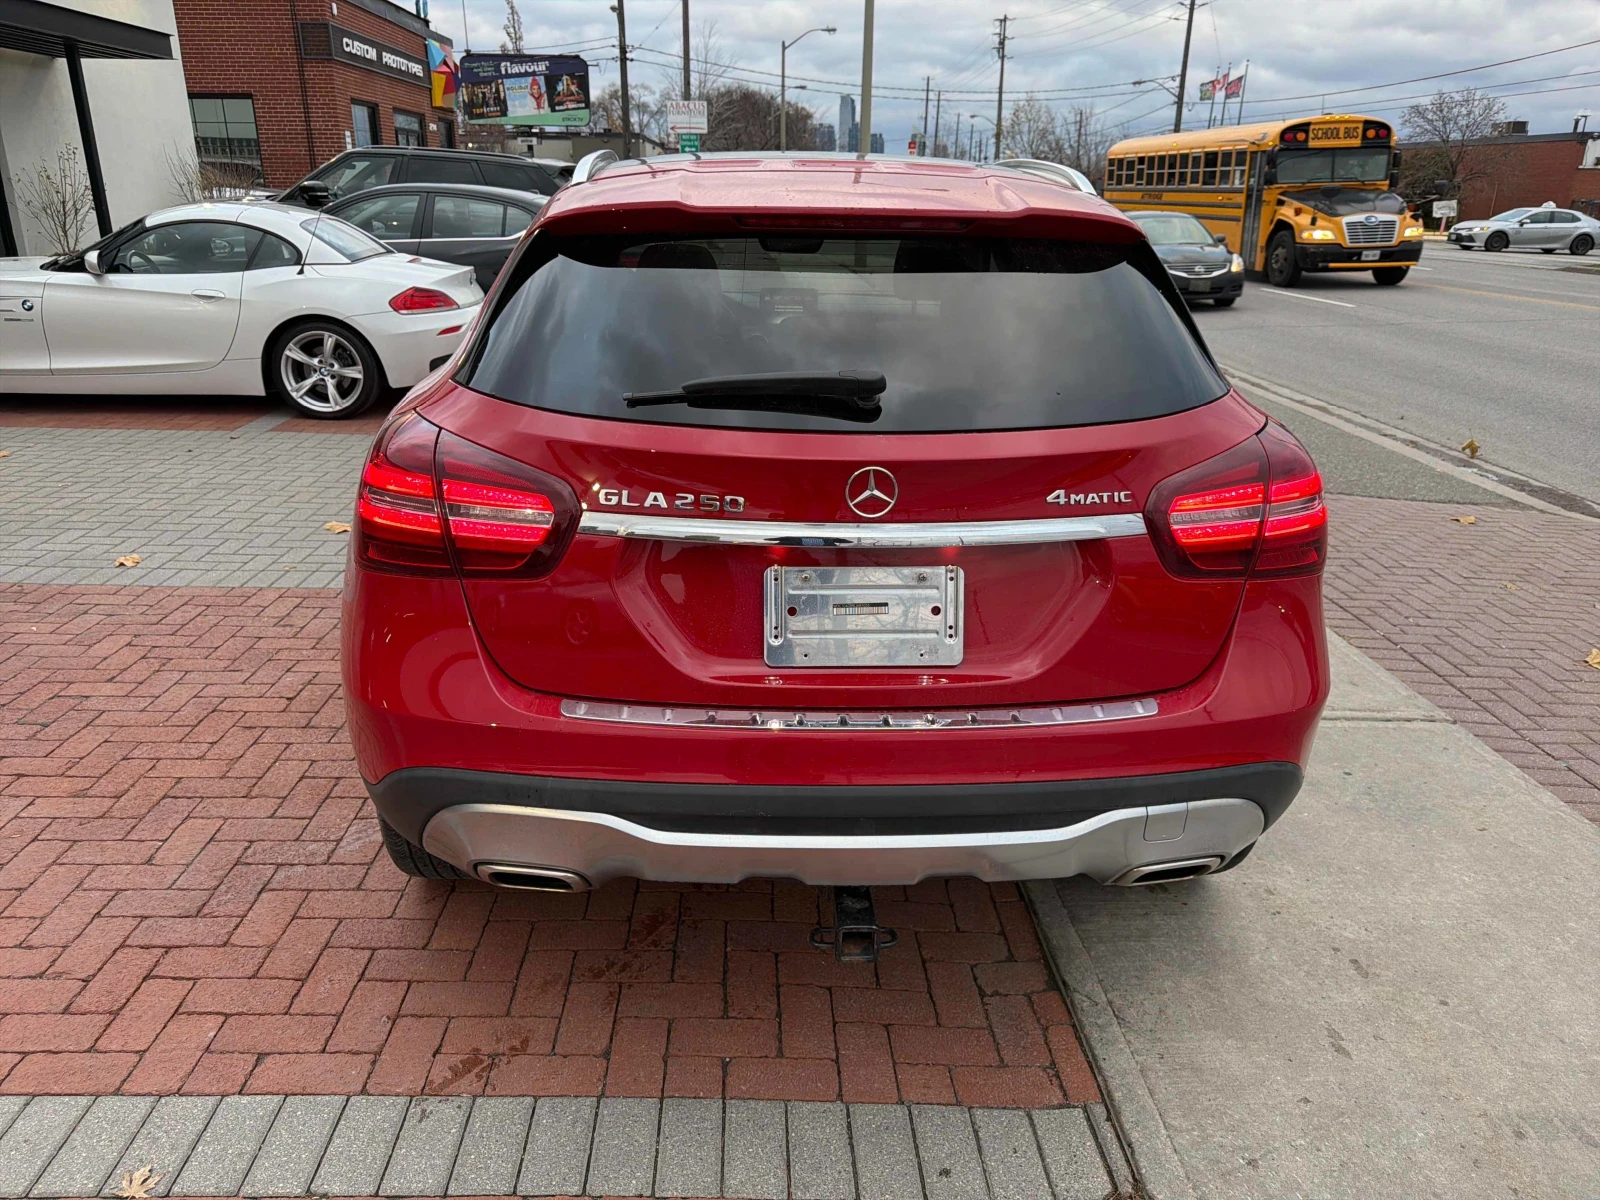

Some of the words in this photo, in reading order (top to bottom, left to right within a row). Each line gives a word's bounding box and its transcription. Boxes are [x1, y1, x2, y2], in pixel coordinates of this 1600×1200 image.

[342, 37, 377, 61] CUSTOM
[382, 52, 424, 77] PROTOTYPES
[500, 61, 550, 74] flavour
[668, 102, 706, 110] ABACUS
[1311, 127, 1341, 140] SCHOOL
[1343, 126, 1360, 139] BUS
[1046, 489, 1132, 505] 4MATIC
